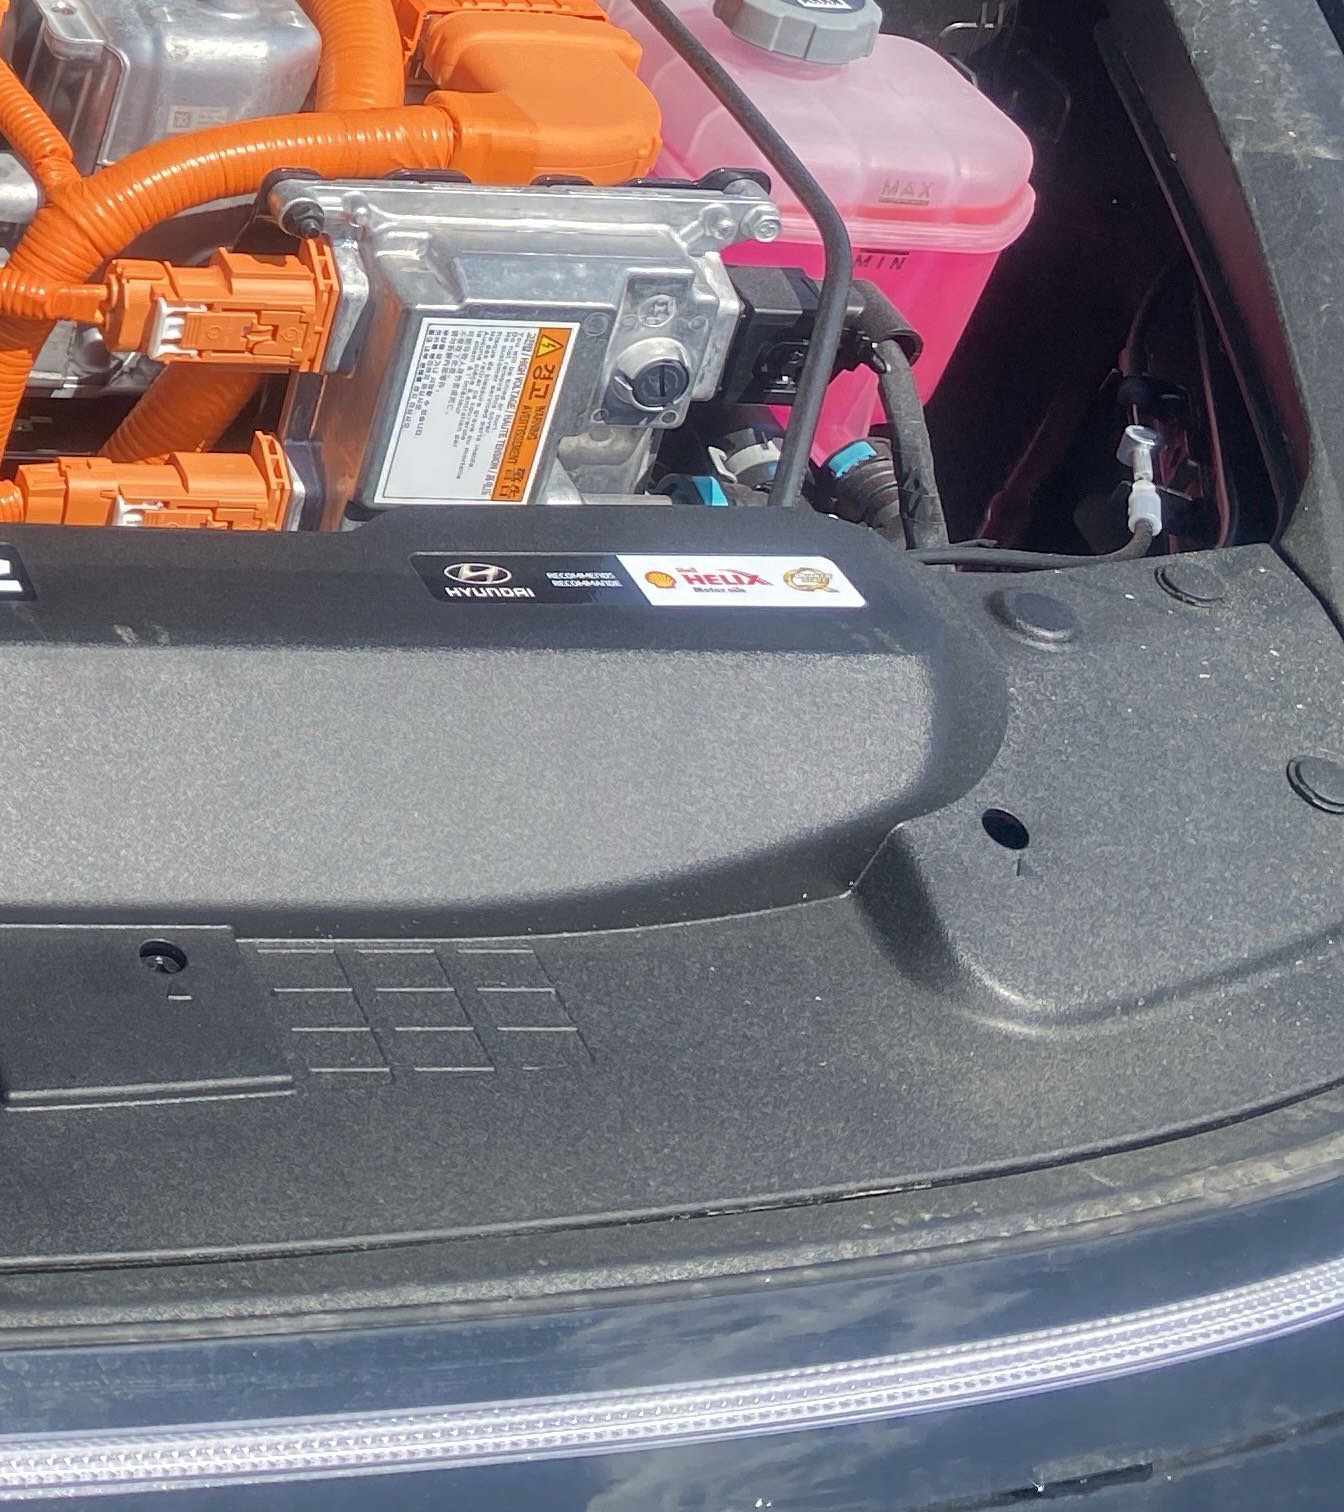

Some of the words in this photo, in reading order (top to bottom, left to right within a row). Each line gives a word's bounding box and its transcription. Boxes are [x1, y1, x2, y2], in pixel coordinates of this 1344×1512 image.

[881, 179, 935, 199] MAX
[855, 254, 907, 270] MIN
[525, 363, 557, 400] 경고
[504, 376, 524, 409] VOLTAGE
[496, 414, 513, 438] HAUTE
[526, 404, 546, 440] WARNING
[545, 572, 616, 580] RECOMMENDS
[551, 579, 624, 588] RECOMMANDE
[681, 574, 768, 586] HELIX
[444, 586, 536, 598] HYUNDAI
